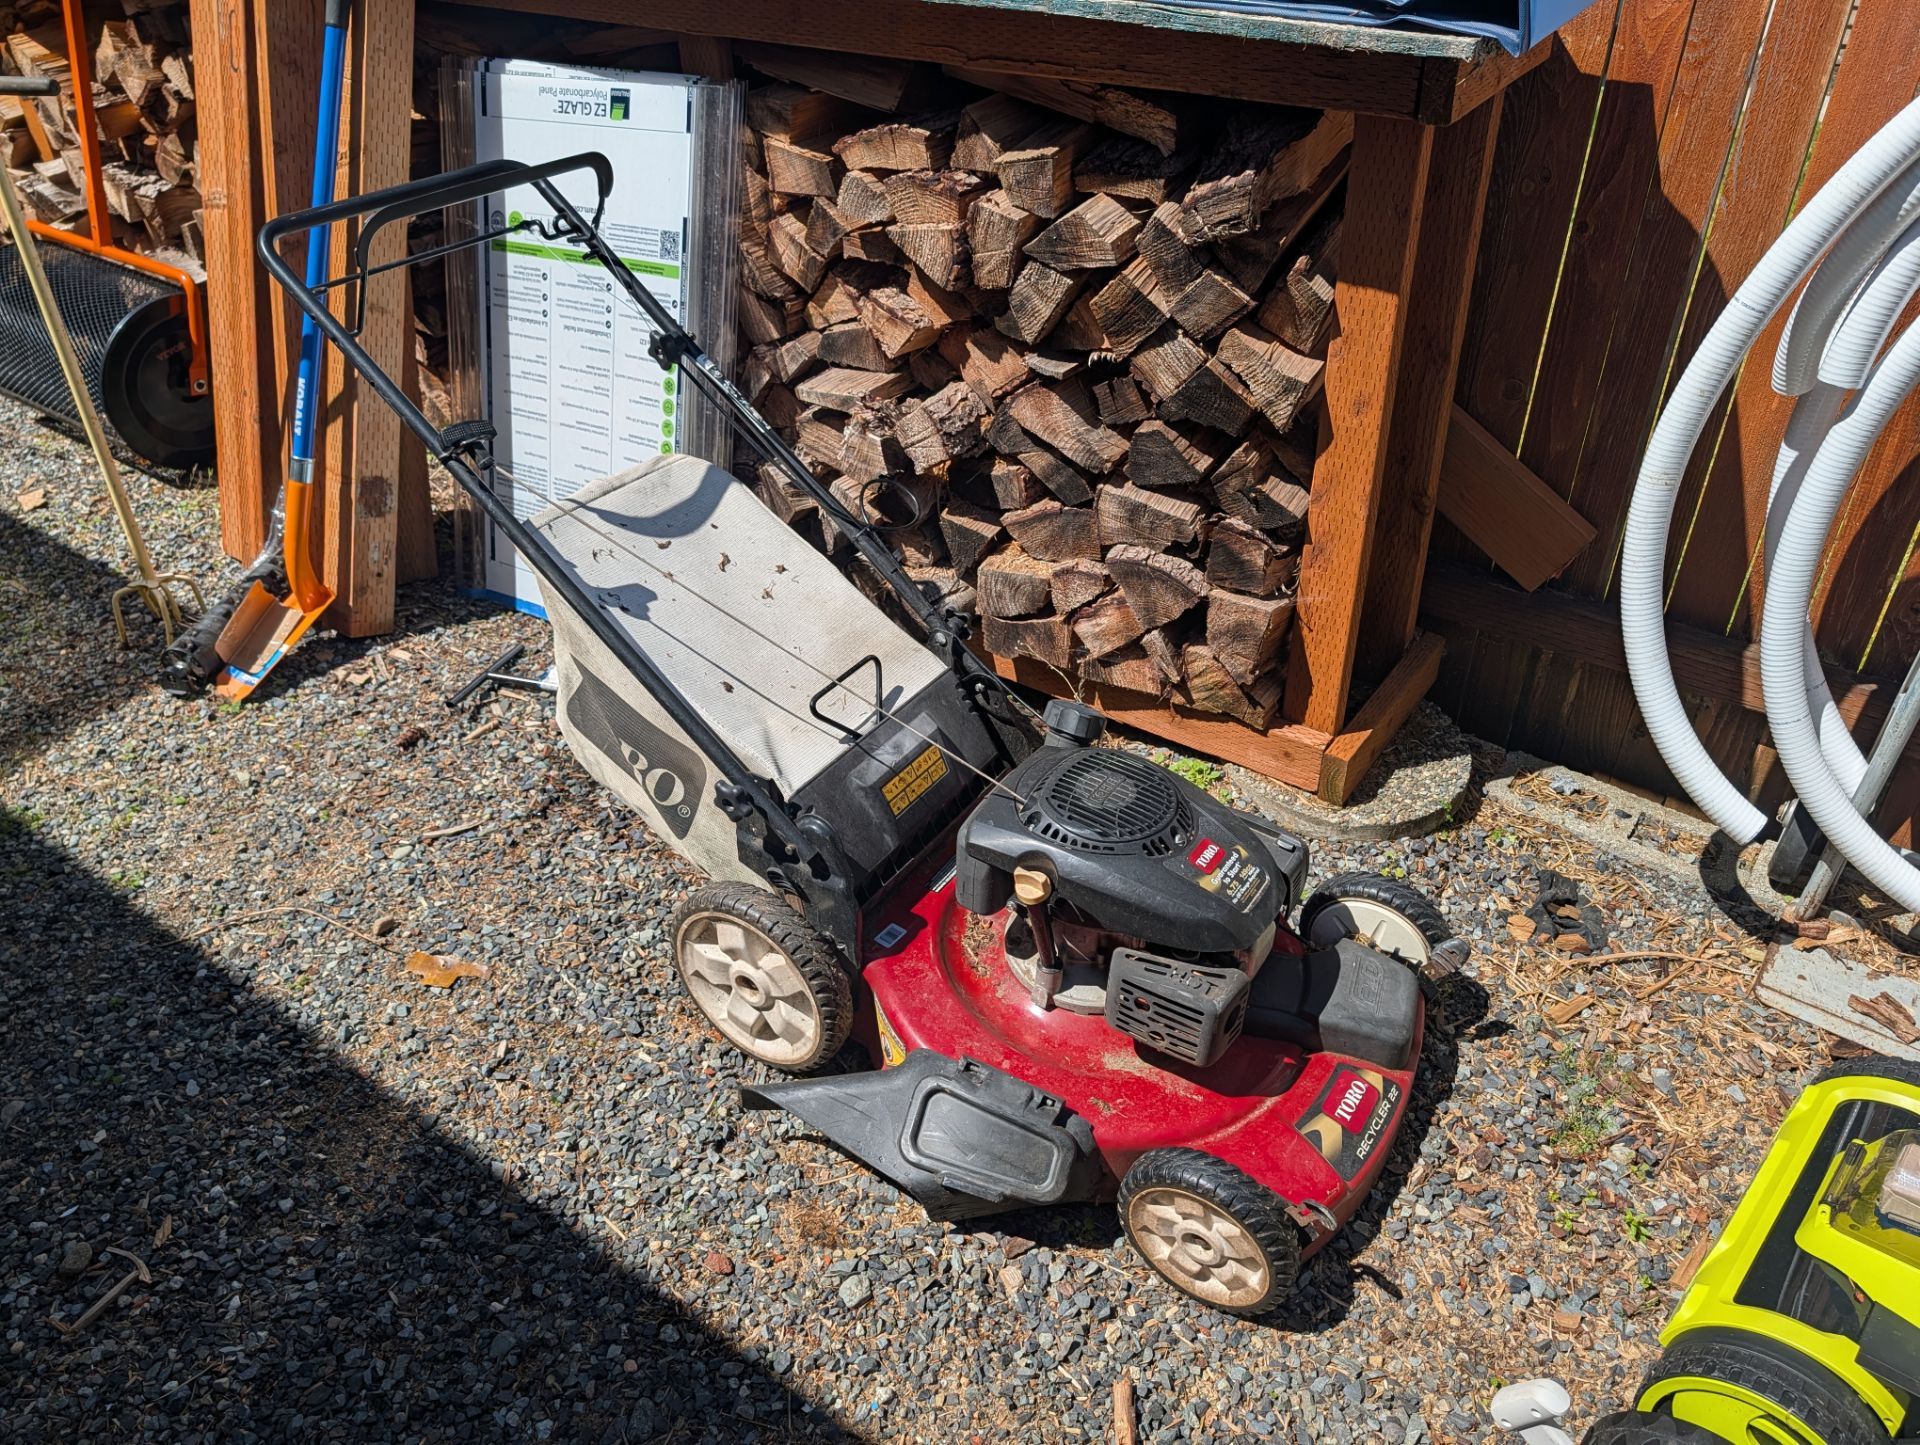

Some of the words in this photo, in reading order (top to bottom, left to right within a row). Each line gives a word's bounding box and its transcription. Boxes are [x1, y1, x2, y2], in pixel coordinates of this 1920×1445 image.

[538, 86, 558, 97] Panel
[558, 87, 608, 101] Polycarbonate
[558, 100, 592, 115] GLAZE
[594, 102, 607, 117] EZ
[294, 377, 305, 436] KOBALT
[1195, 843, 1219, 868] TORO
[1210, 850, 1240, 885] Guaranteed
[1170, 967, 1219, 995] HOT
[1335, 1080, 1367, 1122] TORO
[1356, 1100, 1392, 1160] RECYCLER
